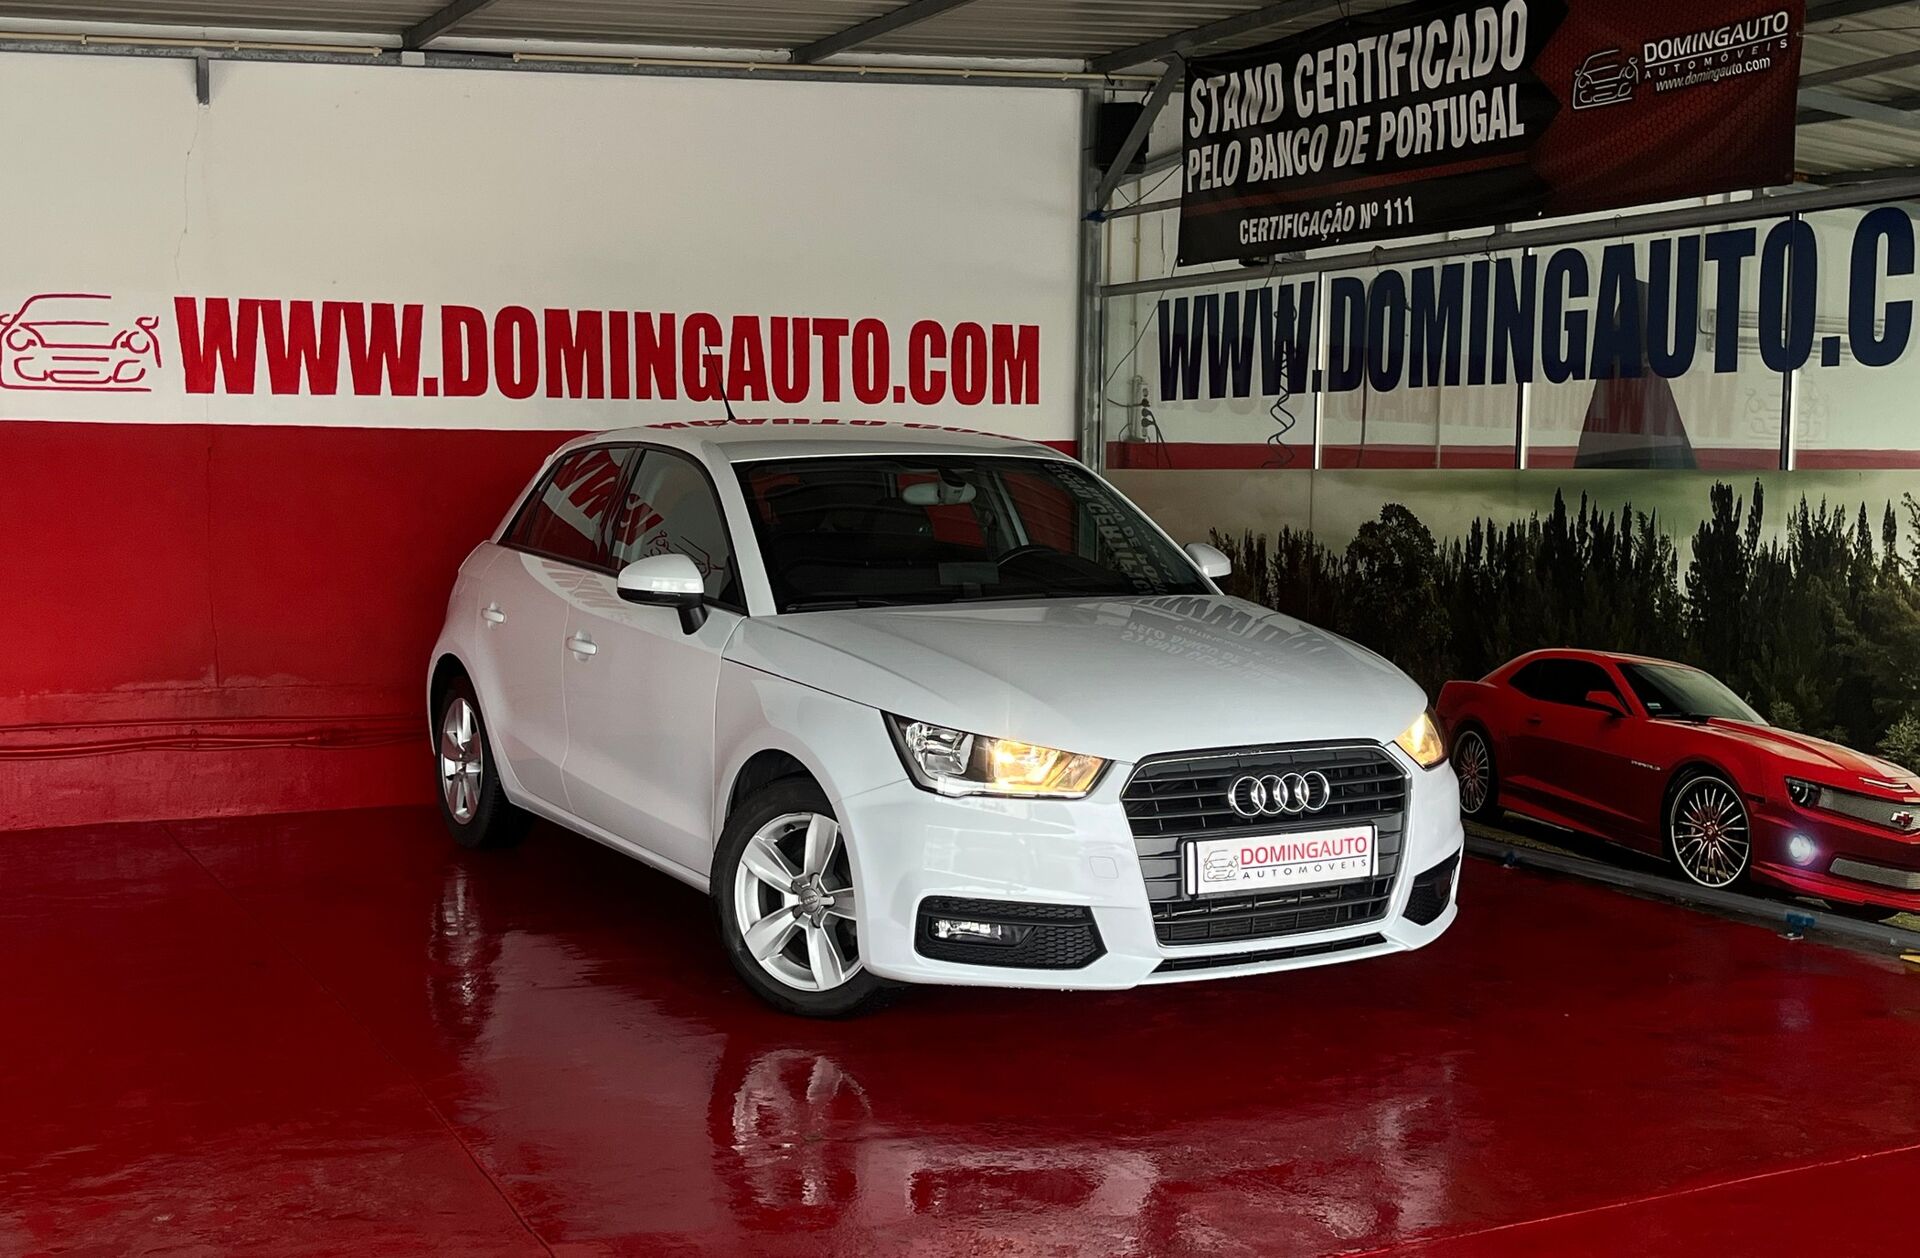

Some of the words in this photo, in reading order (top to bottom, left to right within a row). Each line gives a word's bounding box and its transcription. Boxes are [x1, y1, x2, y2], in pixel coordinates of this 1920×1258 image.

[1644, 11, 1789, 63] DOMINGAUTO
[1189, 62, 1284, 139] STAND
[1294, 0, 1528, 119] CERTIFICADO
[1655, 57, 1771, 92] www.domingauto.com
[1187, 140, 1241, 193] PELO
[1247, 124, 1328, 183] BANCO
[1333, 116, 1371, 168] DE
[1376, 83, 1525, 161] PORTUGAL
[1239, 201, 1355, 245] CERTIFICAÇÃO
[1384, 196, 1414, 226] 111
[174, 297, 1039, 405] WWW.DOMINGAUTO.COM
[1241, 836, 1368, 866] DOMINGAUTO
